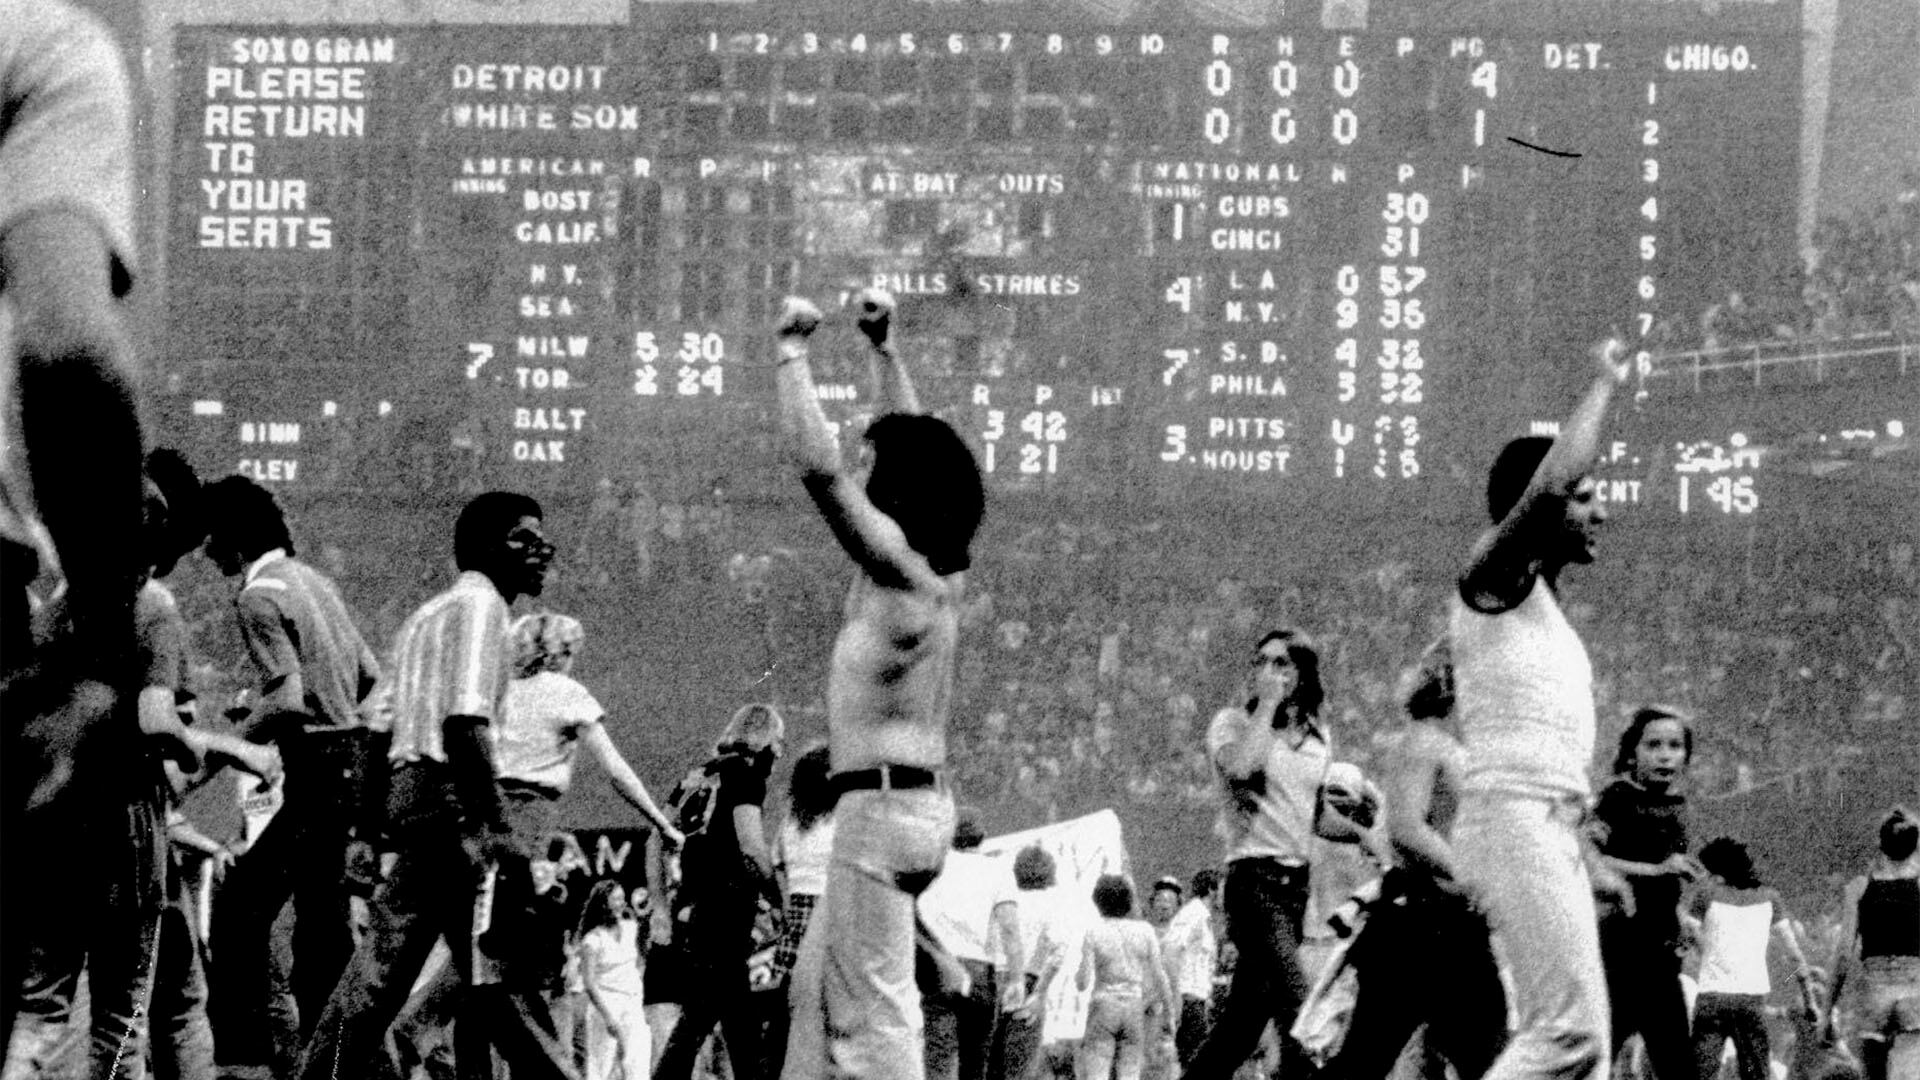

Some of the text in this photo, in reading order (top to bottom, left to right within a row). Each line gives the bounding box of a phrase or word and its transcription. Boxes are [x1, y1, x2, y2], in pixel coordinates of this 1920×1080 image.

[709, 32, 719, 52] 1
[754, 33, 770, 54] 2
[802, 32, 818, 54] 3
[850, 33, 867, 54] 4
[899, 32, 916, 55] 5
[947, 33, 964, 55] 6
[998, 32, 1013, 53] 7
[1046, 33, 1063, 55] 8
[1095, 34, 1113, 56] 9
[1140, 33, 1165, 55] 10
[1211, 33, 1230, 55] R
[1277, 36, 1294, 57] H
[1338, 36, 1354, 58] E
[1397, 37, 1415, 57] P
[1544, 42, 1610, 70] DET.
[205, 65, 366, 100] PLEASE
[452, 63, 606, 92] DETROIT
[1204, 59, 1233, 97] 0
[1270, 59, 1298, 98] 0
[1470, 60, 1498, 99] 4
[1647, 82, 1657, 105] 1
[204, 104, 365, 138] RETURN
[452, 103, 557, 131] WHITE
[571, 104, 639, 131] SOX
[1203, 106, 1231, 145] 0
[1331, 107, 1359, 146] 0
[1474, 108, 1486, 147] 1
[1642, 119, 1660, 146] 2
[462, 157, 718, 179] AMERICAN R P
[1155, 161, 1301, 183] NATIONAL
[1397, 163, 1416, 184] P
[1643, 158, 1659, 183] 3
[200, 178, 308, 212] YOUR
[871, 171, 958, 194] AT BAT
[998, 172, 1064, 195] OUTS
[523, 189, 592, 212] BOST
[1217, 194, 1291, 219] CUBS
[1381, 191, 1430, 226] 30
[1640, 196, 1658, 222] 4
[200, 214, 332, 250] SEATS
[1210, 225, 1420, 258] CINCI 31
[1639, 235, 1656, 261] 5
[977, 274, 1081, 296] STRIKES
[1165, 276, 1192, 314] 4
[1259, 268, 1276, 291] A
[1378, 264, 1428, 300] 57
[1638, 275, 1656, 300] 6
[519, 294, 576, 318] SEA
[1334, 298, 1359, 330] 9
[1638, 312, 1653, 336] 7
[516, 335, 590, 358] MILW
[634, 330, 661, 363] 5
[676, 331, 726, 364] 30
[1162, 348, 1190, 387] 7
[1260, 340, 1287, 365] D.
[1334, 338, 1358, 369] 4
[515, 366, 570, 390] TOR
[1209, 373, 1288, 397] PHILA
[1337, 370, 1357, 403] 3
[972, 383, 990, 406] R
[1035, 384, 1053, 406] P
[513, 407, 587, 431] BALT
[981, 408, 1068, 443] 3 42
[1208, 416, 1286, 441] PITTS
[512, 440, 565, 462] OAK
[984, 440, 1060, 475] 1 21
[1679, 475, 1690, 514] 1
[1705, 475, 1759, 514] 45
